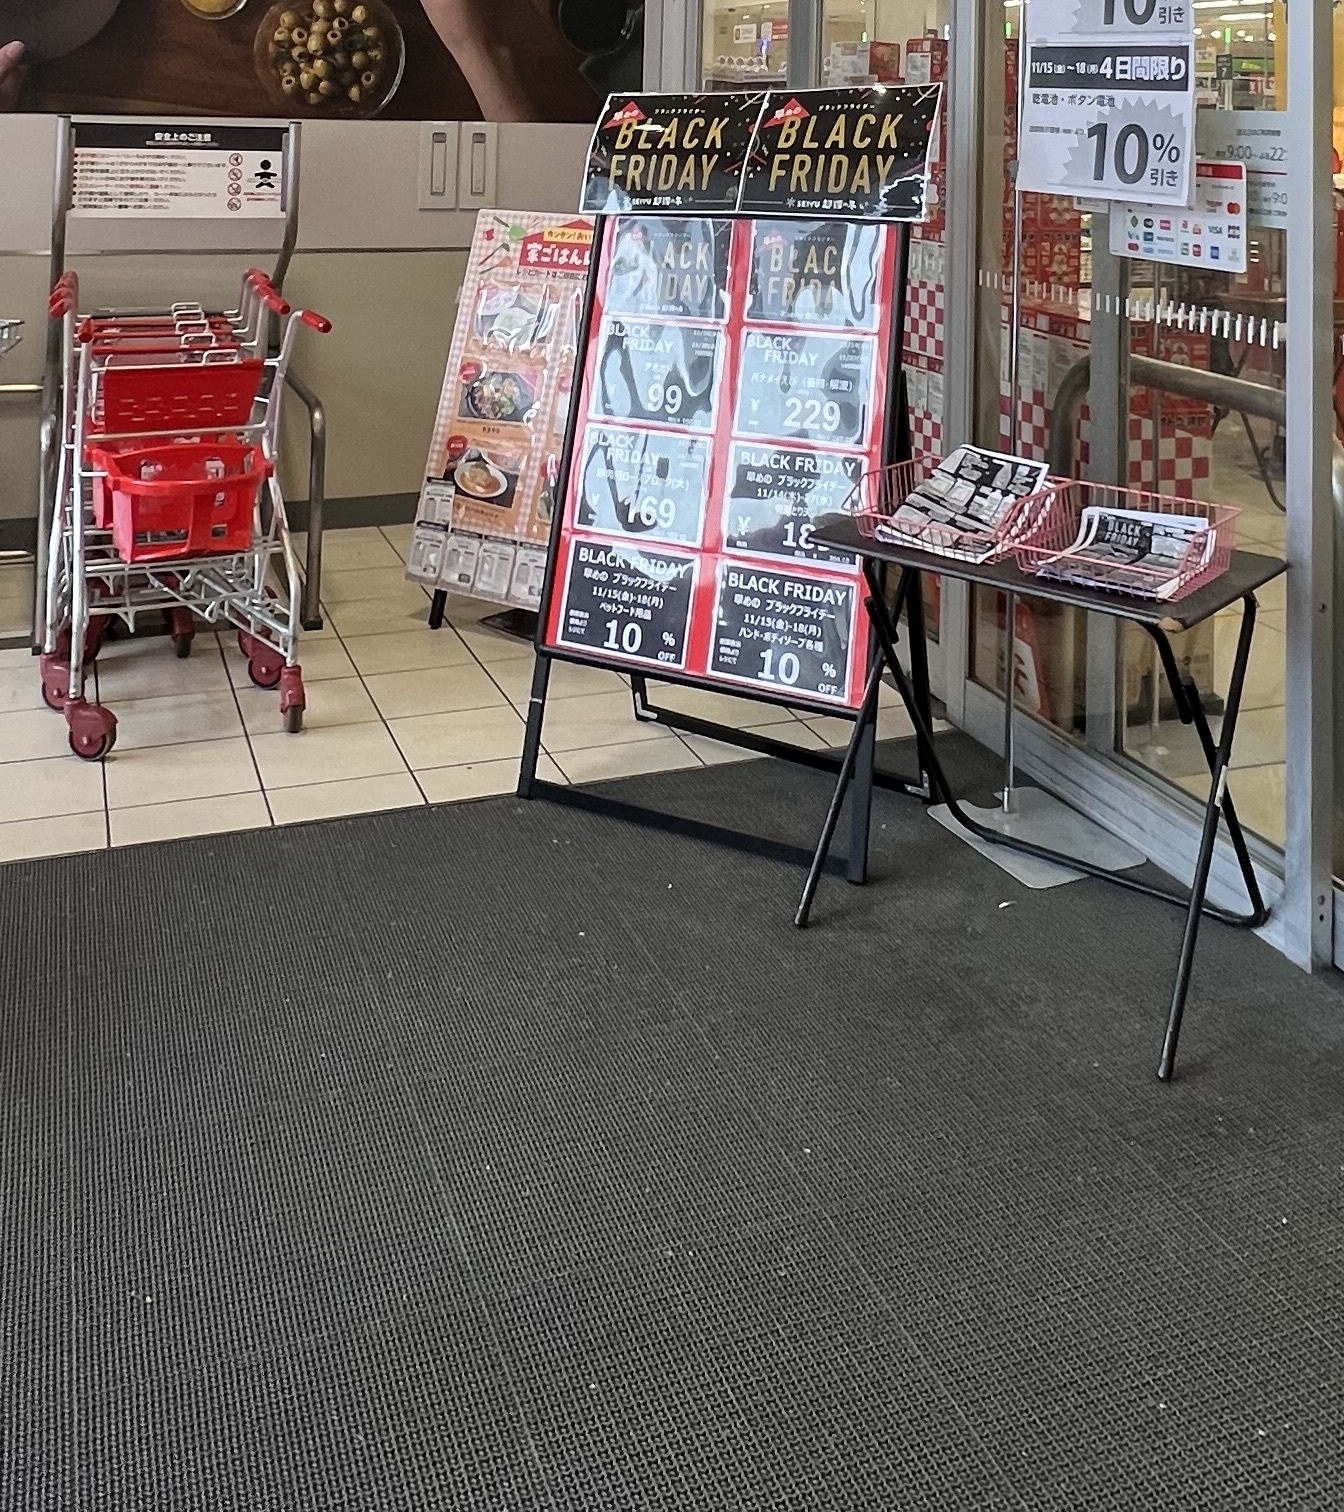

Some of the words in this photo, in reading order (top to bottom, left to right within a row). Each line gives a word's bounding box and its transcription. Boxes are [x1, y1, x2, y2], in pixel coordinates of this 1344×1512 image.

[1158, 6, 1185, 25] 引き
[1221, 67, 1227, 78] 7
[614, 117, 730, 150] BLACK
[777, 113, 904, 149] BLACK
[608, 153, 720, 192] FRIDAY
[768, 153, 895, 194] FRIDAY
[1149, 168, 1179, 187] 引き
[796, 199, 821, 209] SEIYU
[769, 243, 839, 276] BLAC
[622, 337, 674, 354] FRIDAY
[746, 333, 793, 351] BLACK
[763, 349, 819, 367] FRIDAY
[647, 383, 683, 415] 99
[783, 397, 841, 432] 229
[606, 447, 661, 467] FRIDAY
[740, 451, 792, 470] BLACK
[795, 456, 856, 477] FRIDAY
[624, 495, 677, 529] 169
[737, 516, 751, 536] ¥
[782, 521, 830, 552] 18
[1107, 519, 1142, 538] BLACK
[1104, 531, 1139, 547] FRIDAY
[578, 547, 627, 570] BLACK
[630, 556, 690, 580] FRIDAY
[583, 567, 609, 582] 早めの
[612, 572, 678, 593] ブラックフライデー
[728, 572, 781, 596] BLACK
[783, 581, 848, 607] FRIDAY
[599, 601, 653, 621] ペットフード用品
[733, 593, 761, 609] 早めの
[765, 598, 836, 621] ブラックフライデー
[602, 618, 643, 654] 10
[661, 631, 677, 647] %
[657, 650, 677, 663] OFF
[757, 648, 800, 686] 10
[821, 662, 837, 679] %
[817, 683, 838, 696] OFF
